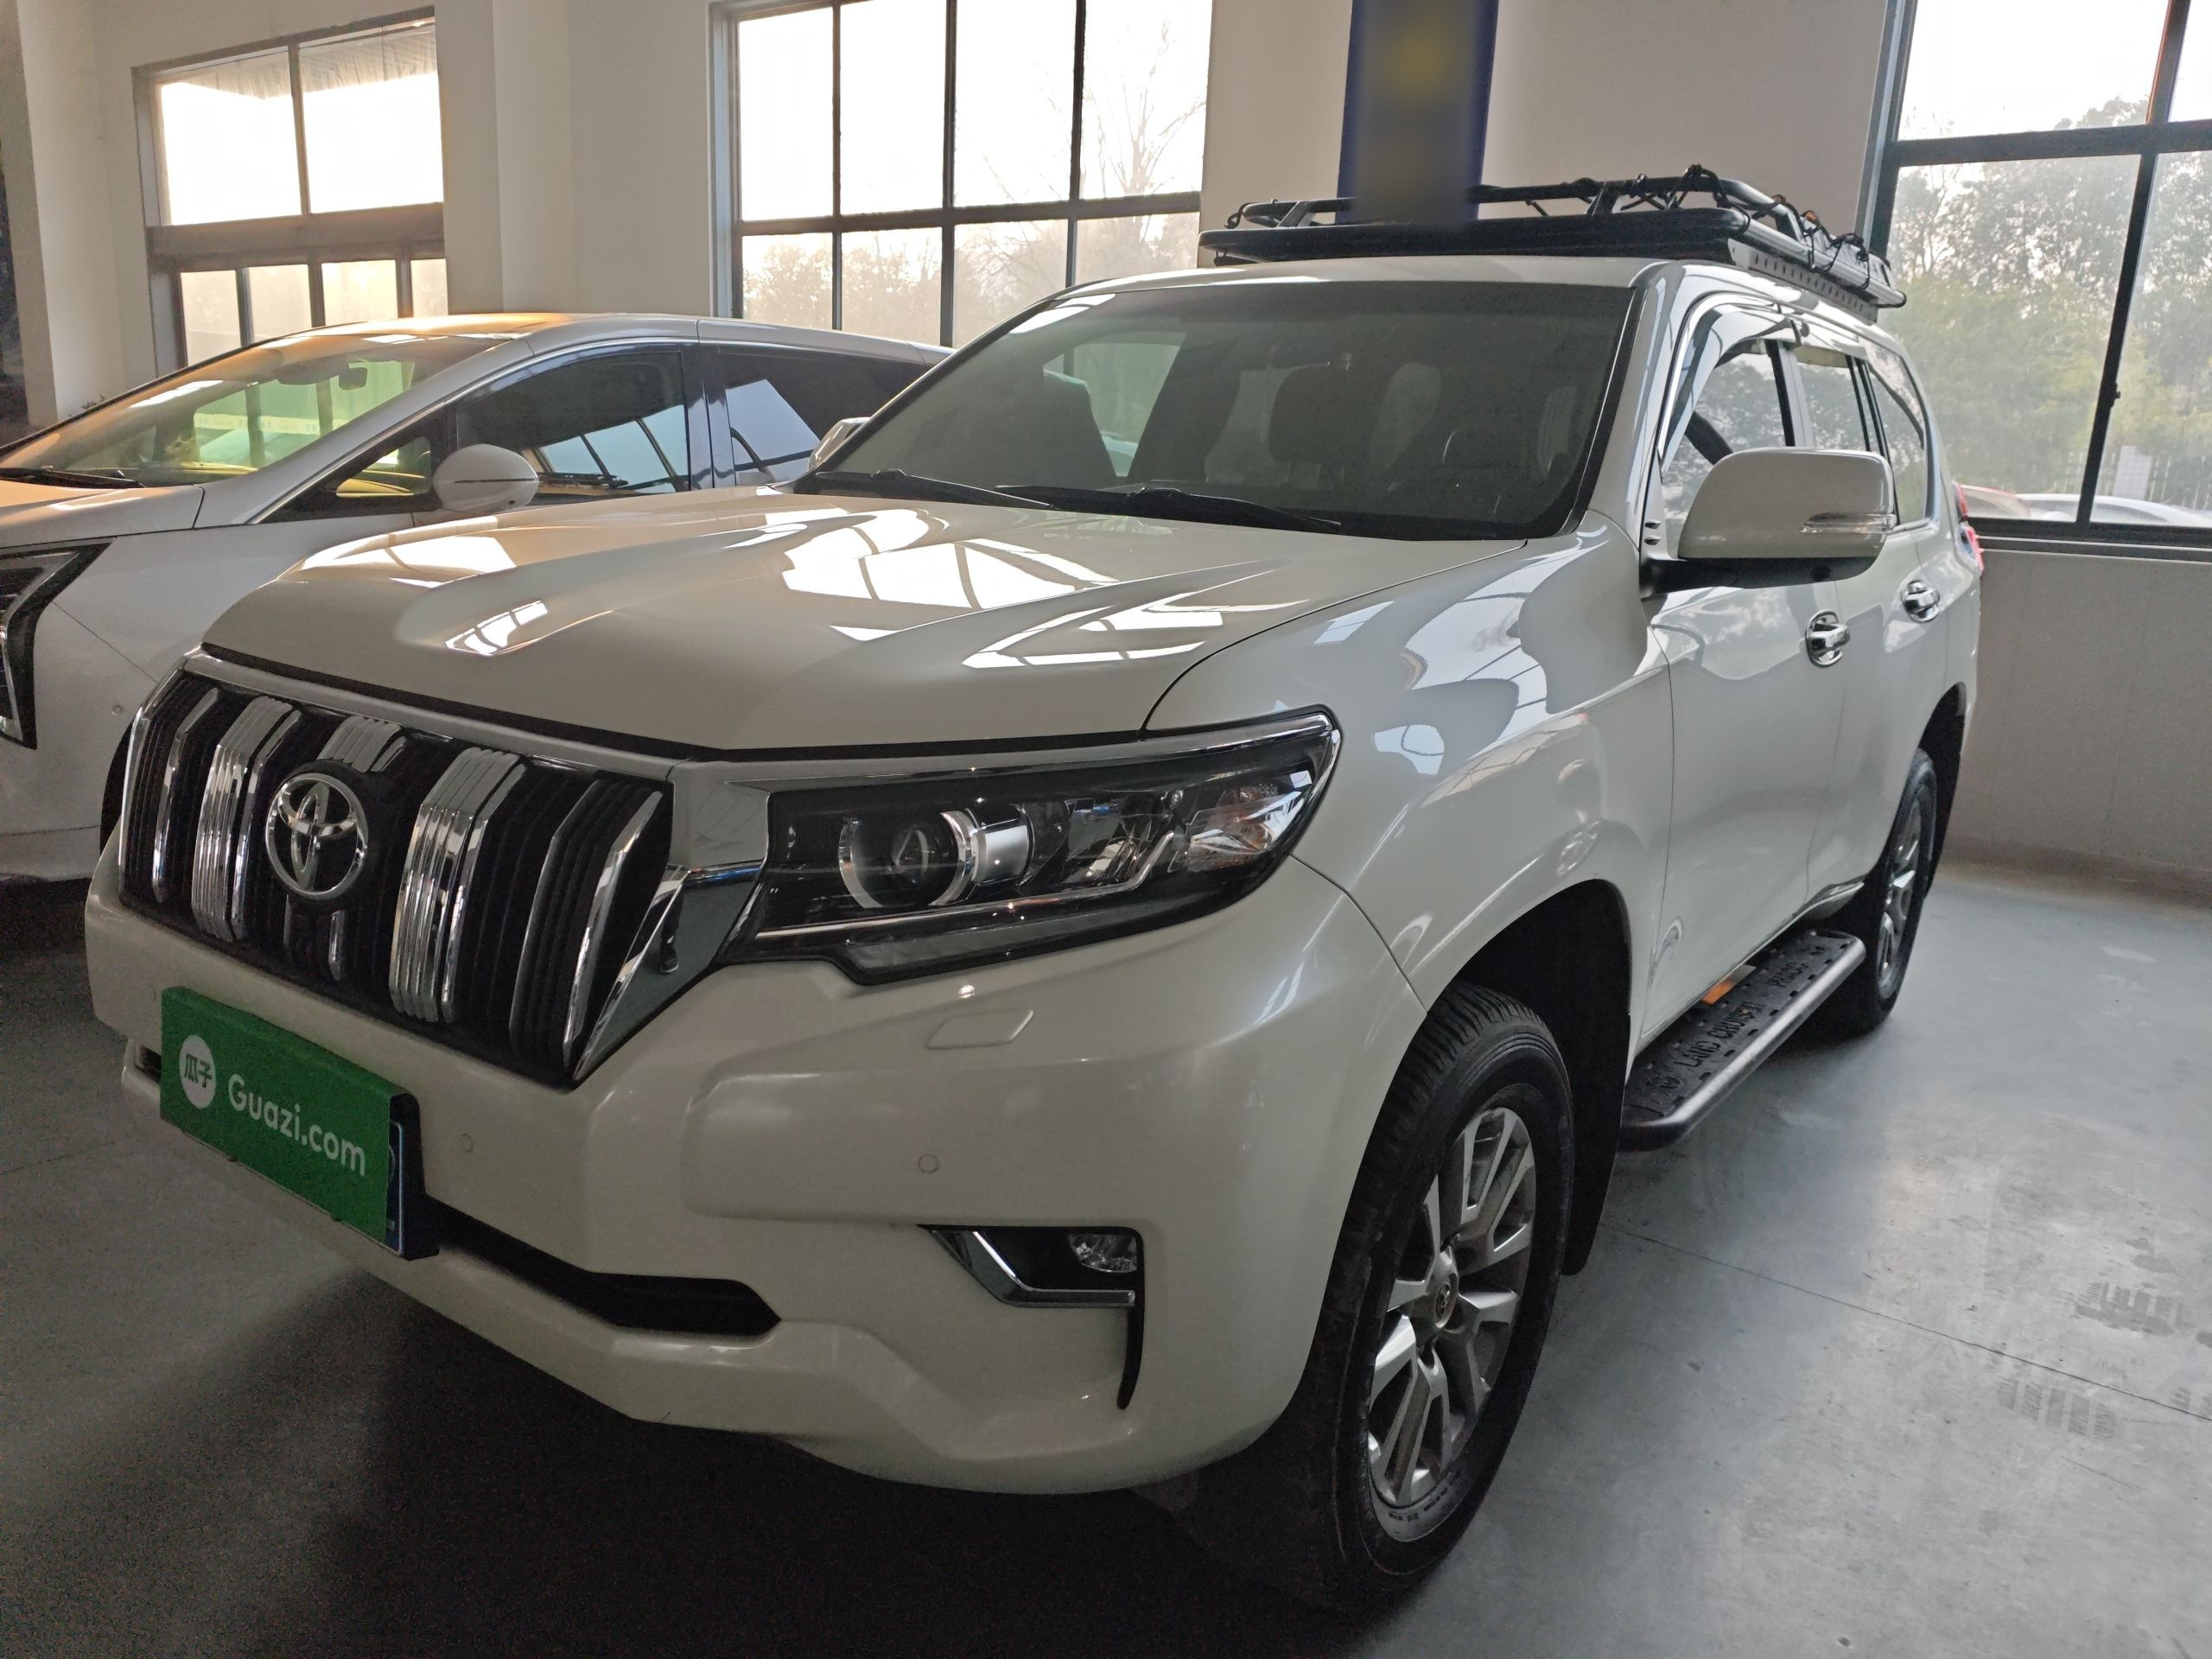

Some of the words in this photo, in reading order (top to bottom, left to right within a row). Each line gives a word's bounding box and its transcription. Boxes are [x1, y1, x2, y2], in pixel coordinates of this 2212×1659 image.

[184, 1053, 213, 1089] 瓜子
[1673, 1039, 1721, 1068] LAND
[228, 1073, 365, 1177] Guazi.com
